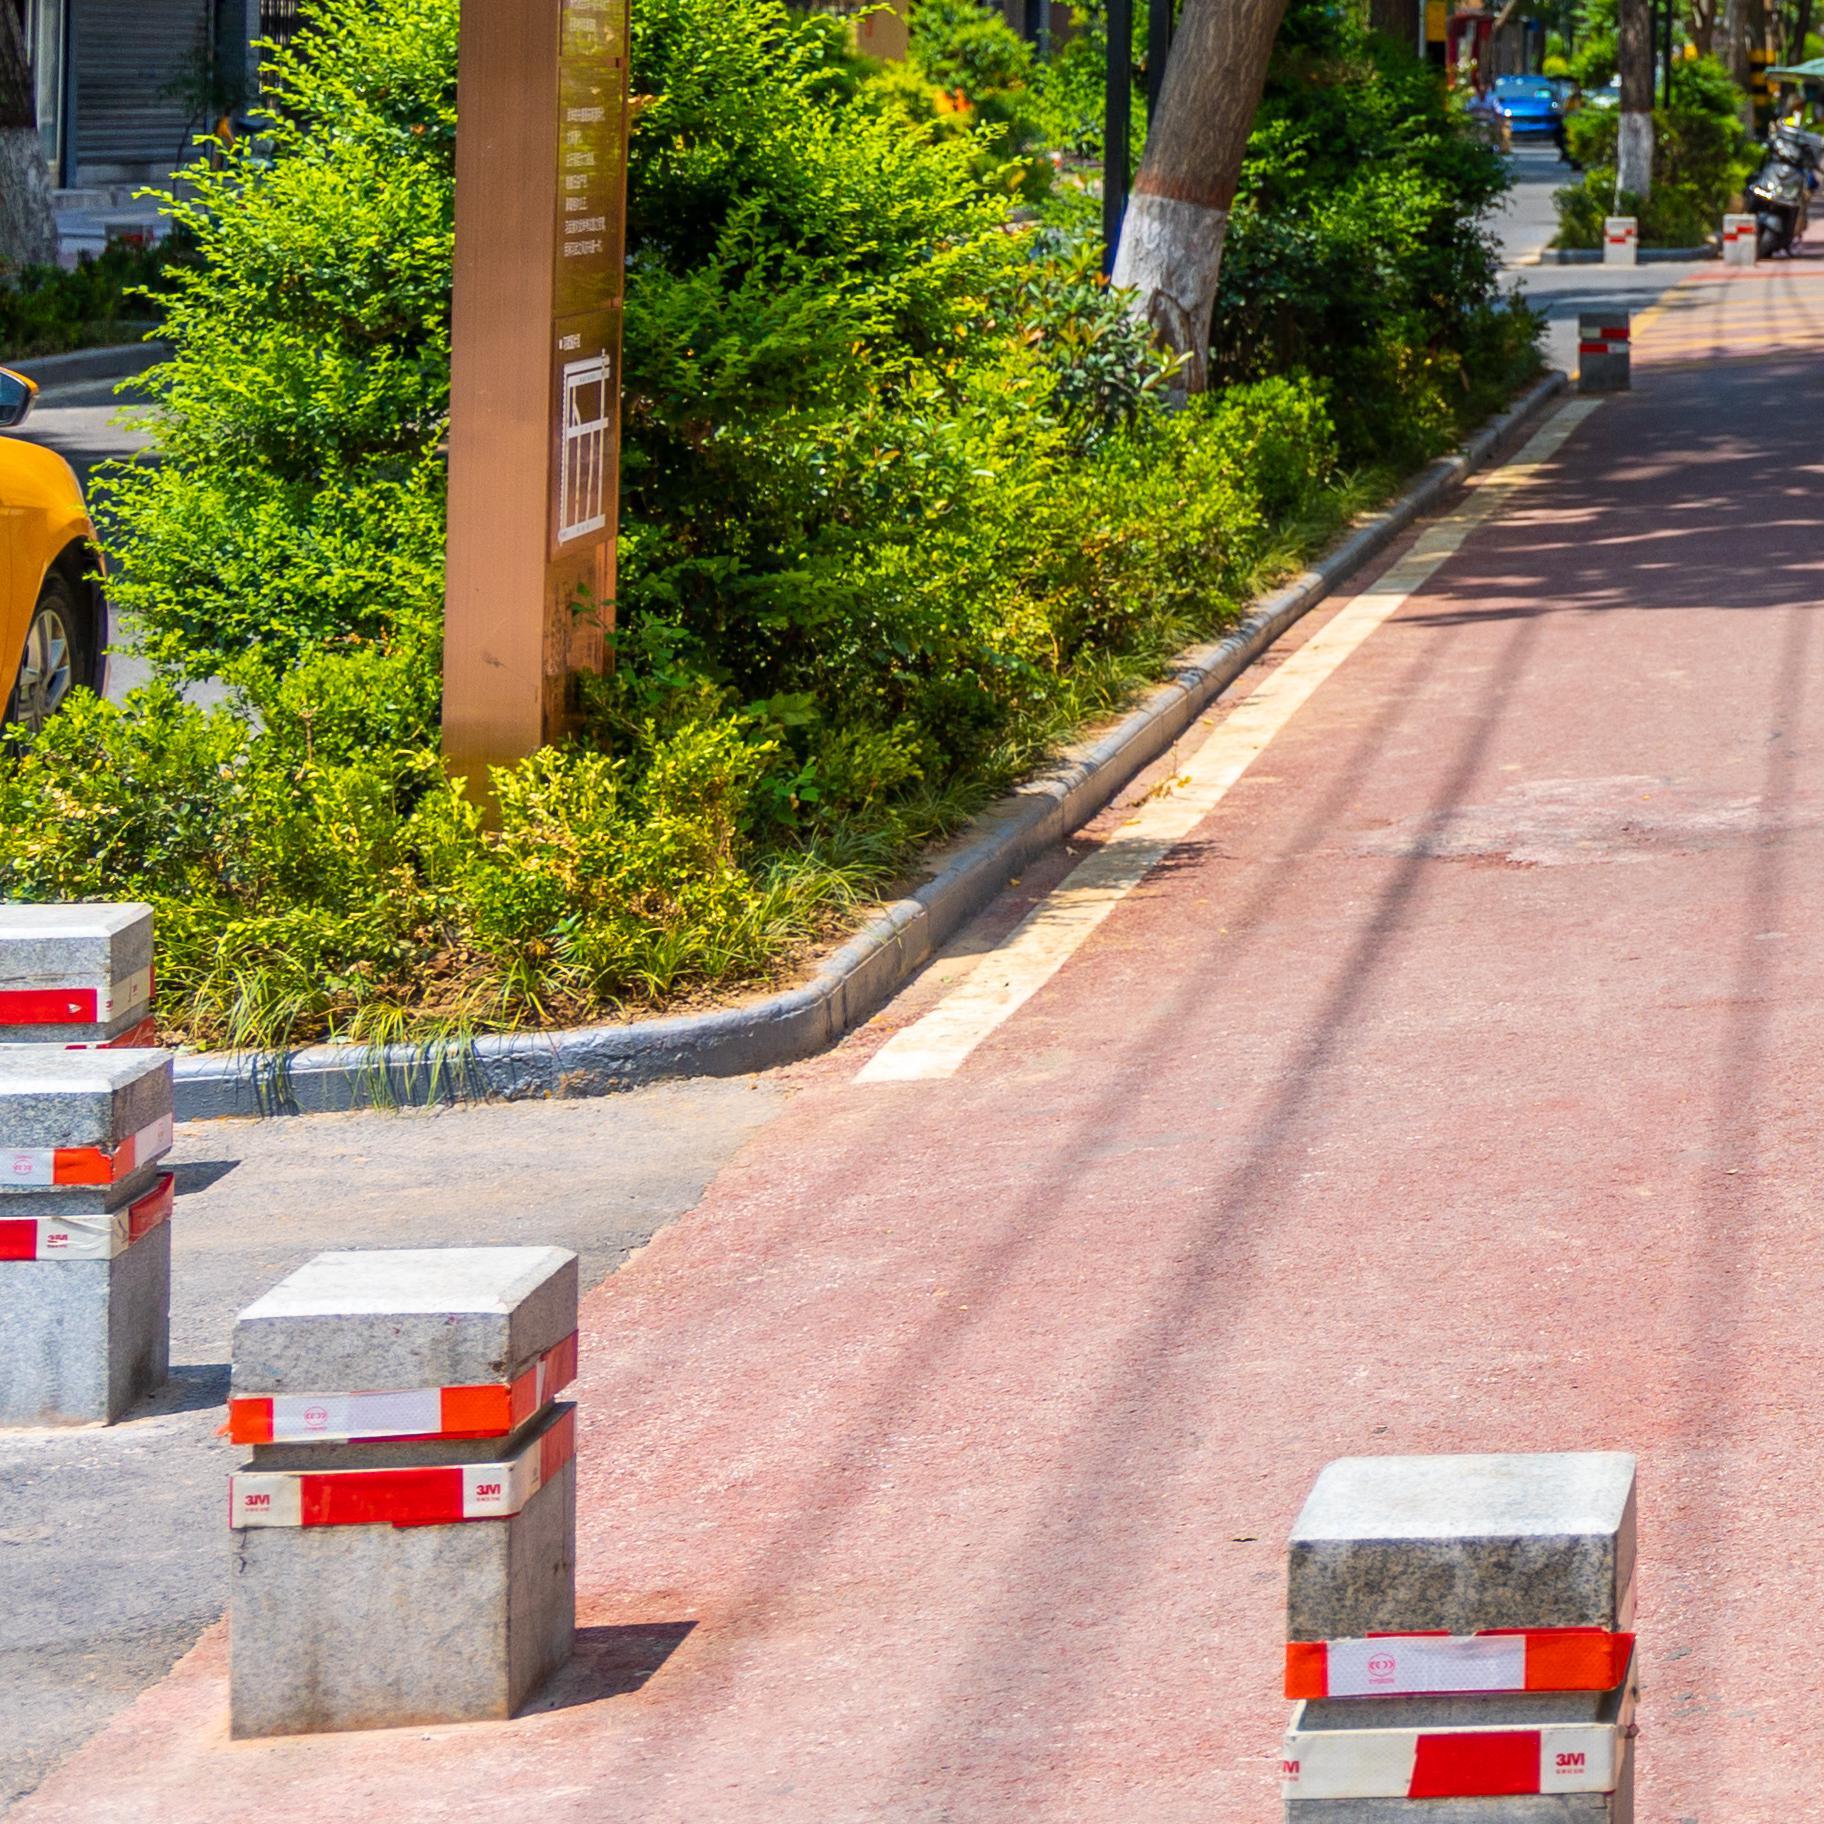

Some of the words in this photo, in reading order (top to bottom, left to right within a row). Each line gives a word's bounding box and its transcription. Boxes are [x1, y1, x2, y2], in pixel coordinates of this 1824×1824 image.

[476, 1483, 501, 1495] 3M
[245, 1494, 271, 1506] 3M
[1556, 1752, 1585, 1766] 3M
